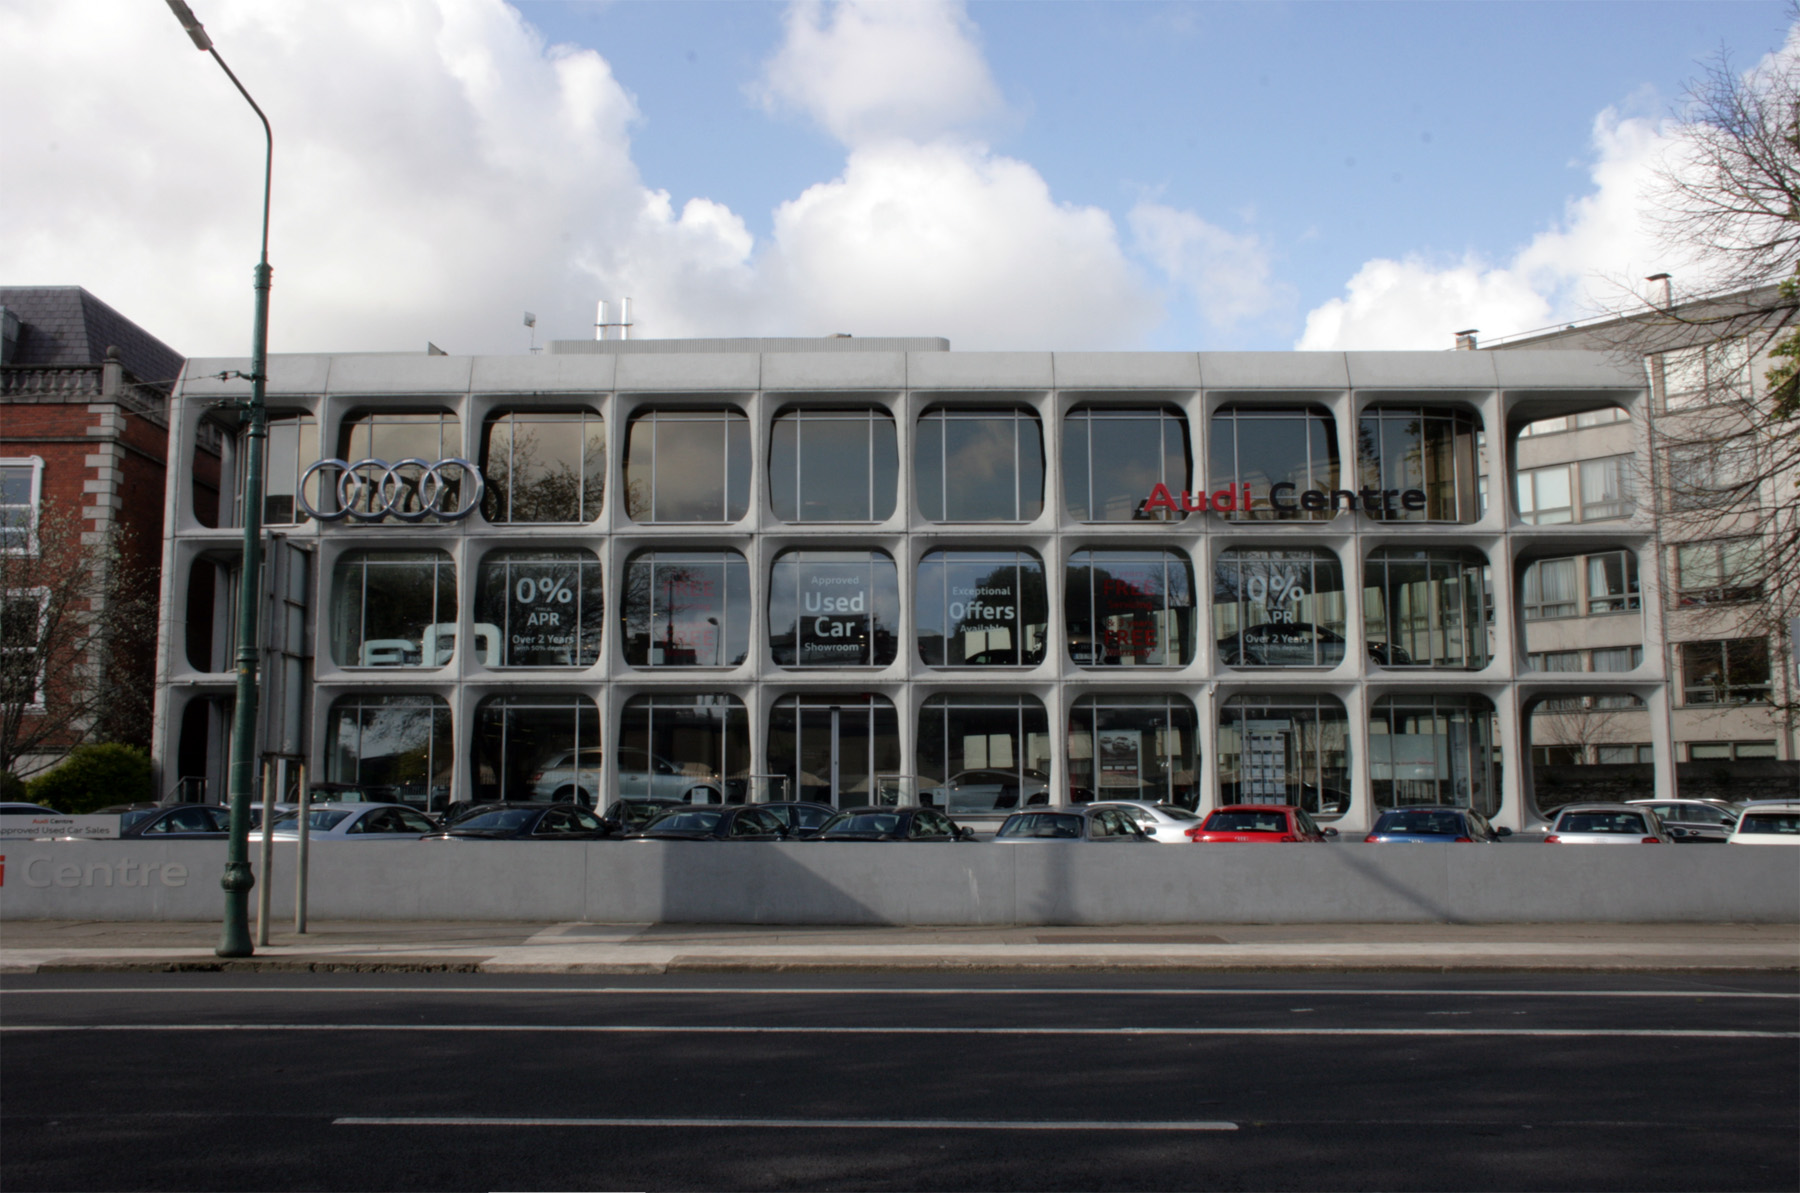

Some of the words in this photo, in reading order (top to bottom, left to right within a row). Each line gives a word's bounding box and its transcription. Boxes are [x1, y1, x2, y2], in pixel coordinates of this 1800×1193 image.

[1143, 482, 1251, 512] Audi
[1269, 482, 1427, 512] Centre
[662, 580, 716, 597] FREE
[811, 575, 859, 586] Approved
[1104, 579, 1156, 596] FREE
[1247, 575, 1304, 602] 0%
[515, 577, 573, 604] 0%
[952, 586, 1011, 598] Exceptional
[804, 591, 864, 613] Used
[950, 600, 1015, 620] Offers
[527, 612, 560, 626] APR
[1262, 610, 1294, 624] APR
[814, 616, 856, 638] Car
[512, 634, 535, 644] Over
[537, 634, 545, 644] 2
[547, 634, 575, 644] Years
[662, 630, 715, 647] FREE
[1105, 629, 1157, 647] FREE
[1245, 633, 1270, 643] Over
[1272, 633, 1279, 643] 2
[1281, 633, 1309, 643] Years
[804, 642, 859, 652] Showroom
[0, 827, 40, 837] pproved
[42, 827, 65, 835] Used
[67, 827, 83, 835] Car
[85, 827, 110, 835] Sales
[21, 855, 189, 889] Centre
